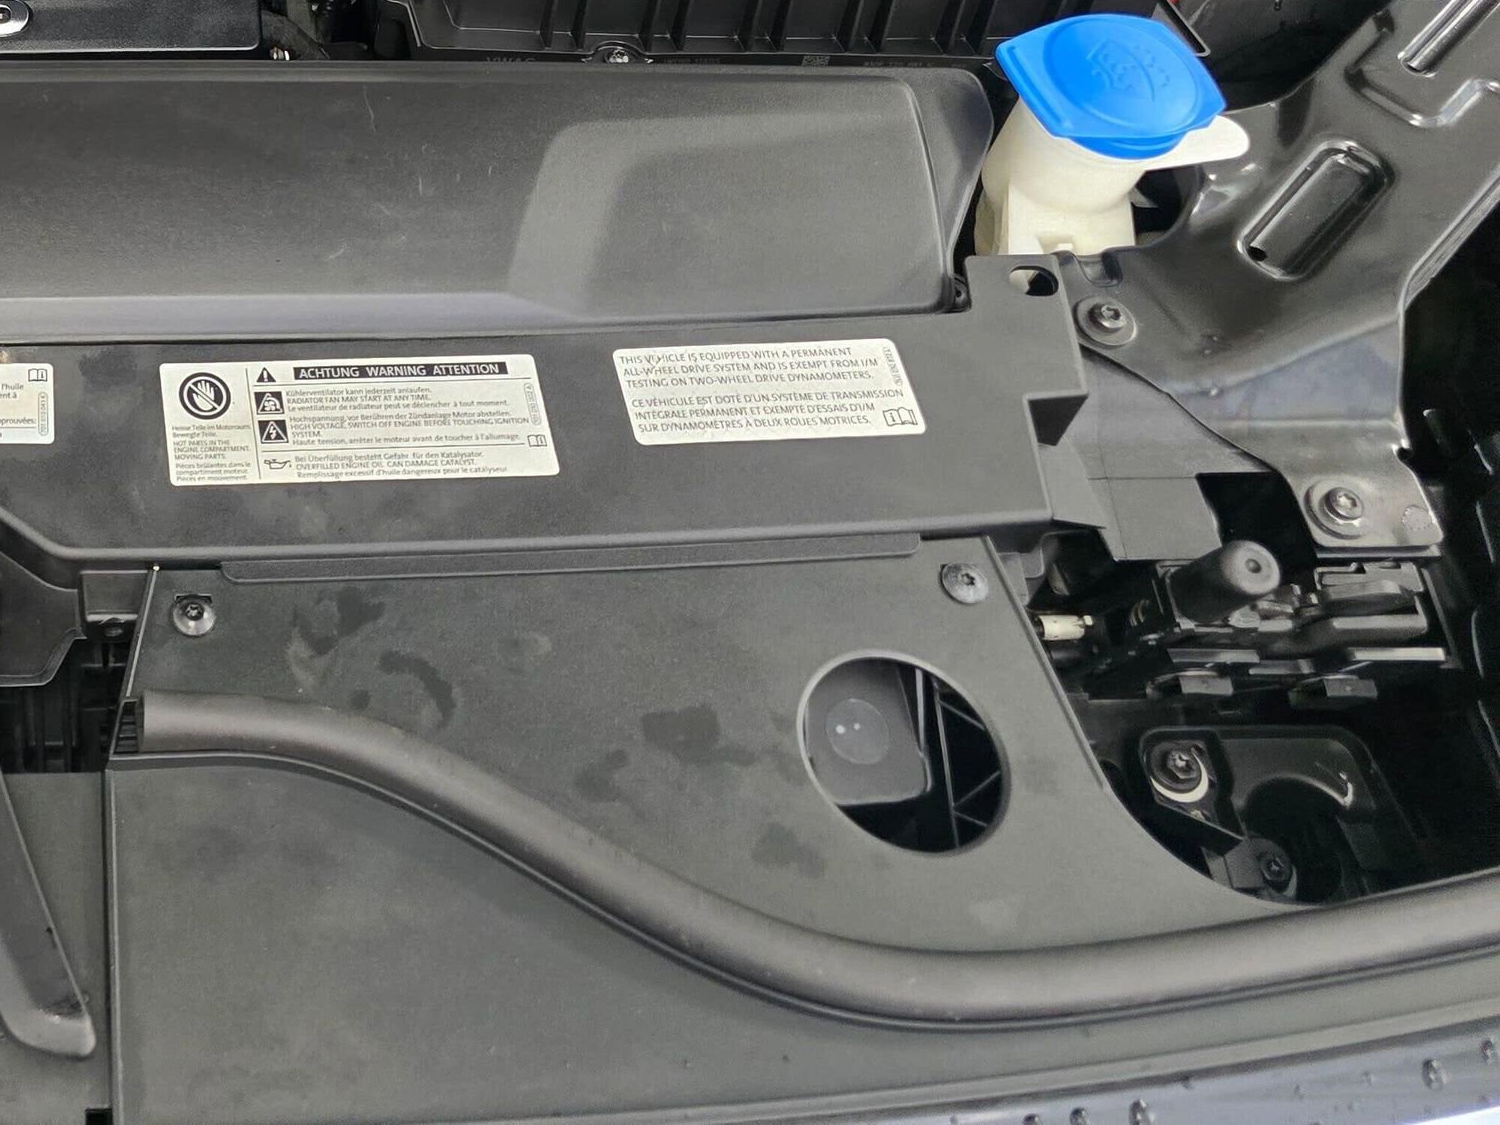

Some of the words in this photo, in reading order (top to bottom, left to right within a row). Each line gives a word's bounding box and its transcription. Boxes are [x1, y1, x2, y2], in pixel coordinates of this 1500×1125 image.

[620, 356, 642, 364] THIS
[688, 354, 698, 362] IS
[700, 352, 750, 362] EQUIPPED
[751, 350, 778, 358] WITH
[782, 350, 790, 358] A
[791, 348, 852, 358] PERMANENT
[300, 366, 360, 378] ACHTUNG
[366, 364, 426, 377] WARNING
[433, 364, 500, 375] ATTENTION
[624, 366, 679, 376] ALL-WHEEL
[681, 364, 710, 374] DRIVE
[714, 363, 750, 372] SYSTEM
[754, 362, 776, 370] AND
[778, 362, 788, 370] IS
[790, 360, 827, 370] EXEMPT
[830, 359, 859, 368] FROM
[861, 358, 878, 366] I/M
[626, 378, 668, 388] TESTING
[671, 378, 687, 386] ON
[690, 376, 754, 386] TWO-WHEEL
[756, 374, 787, 382] DRIVE
[788, 371, 874, 382] DYNAMOMETERS.
[288, 396, 324, 404] RADIATOR
[632, 399, 644, 407] CE
[697, 396, 712, 405] EST
[816, 392, 828, 400] DE
[831, 390, 904, 400] TRANSMISSION
[690, 407, 748, 418] PERMANENT
[751, 406, 761, 416] ET
[639, 424, 659, 432] SUR
[754, 418, 781, 428] DEUX
[784, 417, 817, 426] ROUES
[820, 415, 871, 425] MOTRICES.
[296, 462, 340, 470] OVERFILLED
